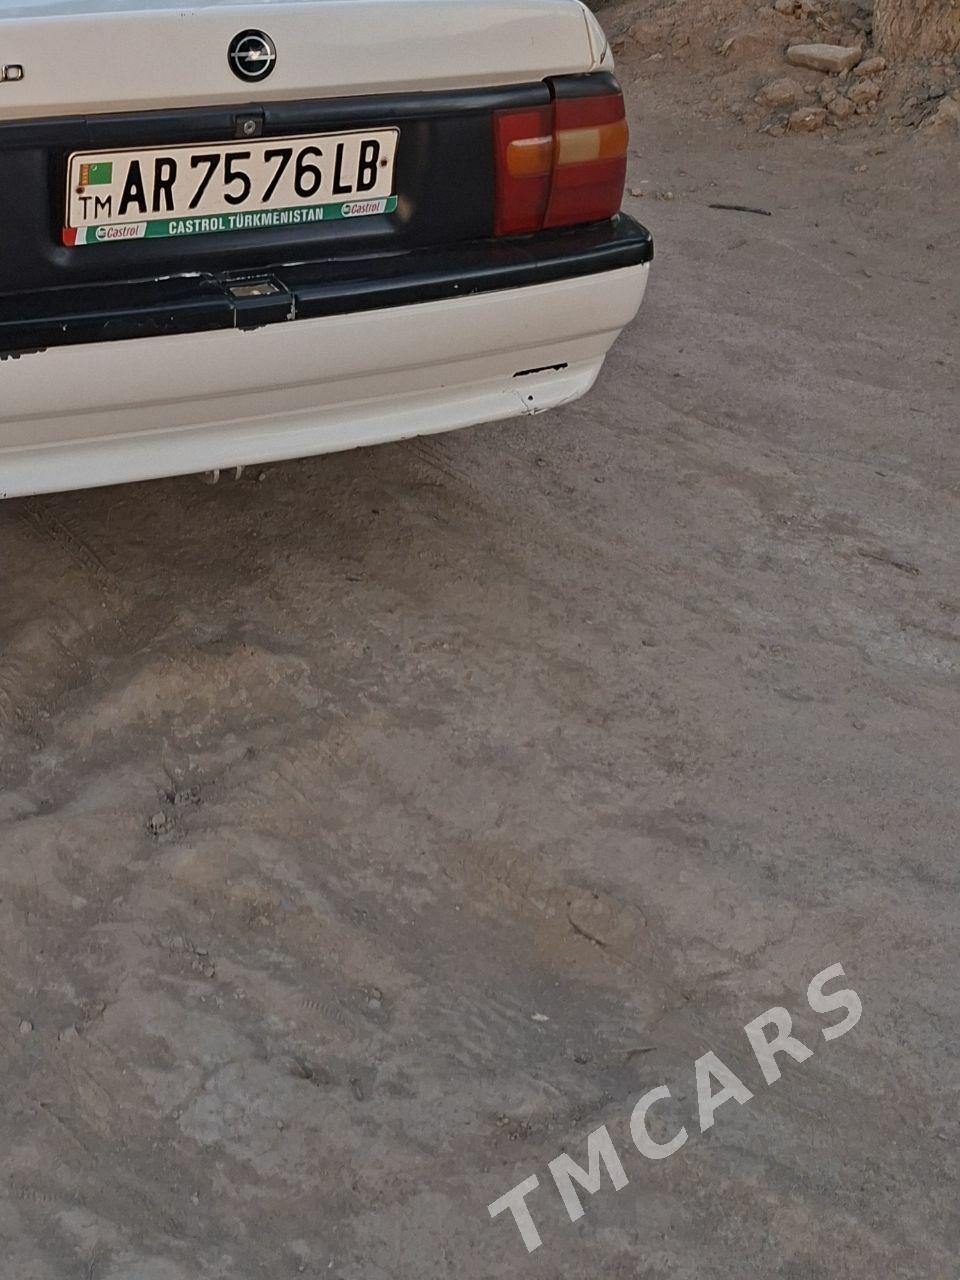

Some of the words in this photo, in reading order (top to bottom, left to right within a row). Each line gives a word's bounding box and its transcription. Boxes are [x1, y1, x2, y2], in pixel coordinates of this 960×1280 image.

[78, 195, 112, 220] TM
[350, 202, 381, 215] Castrol
[106, 225, 139, 238] Castrol
[168, 219, 226, 235] CASTROL
